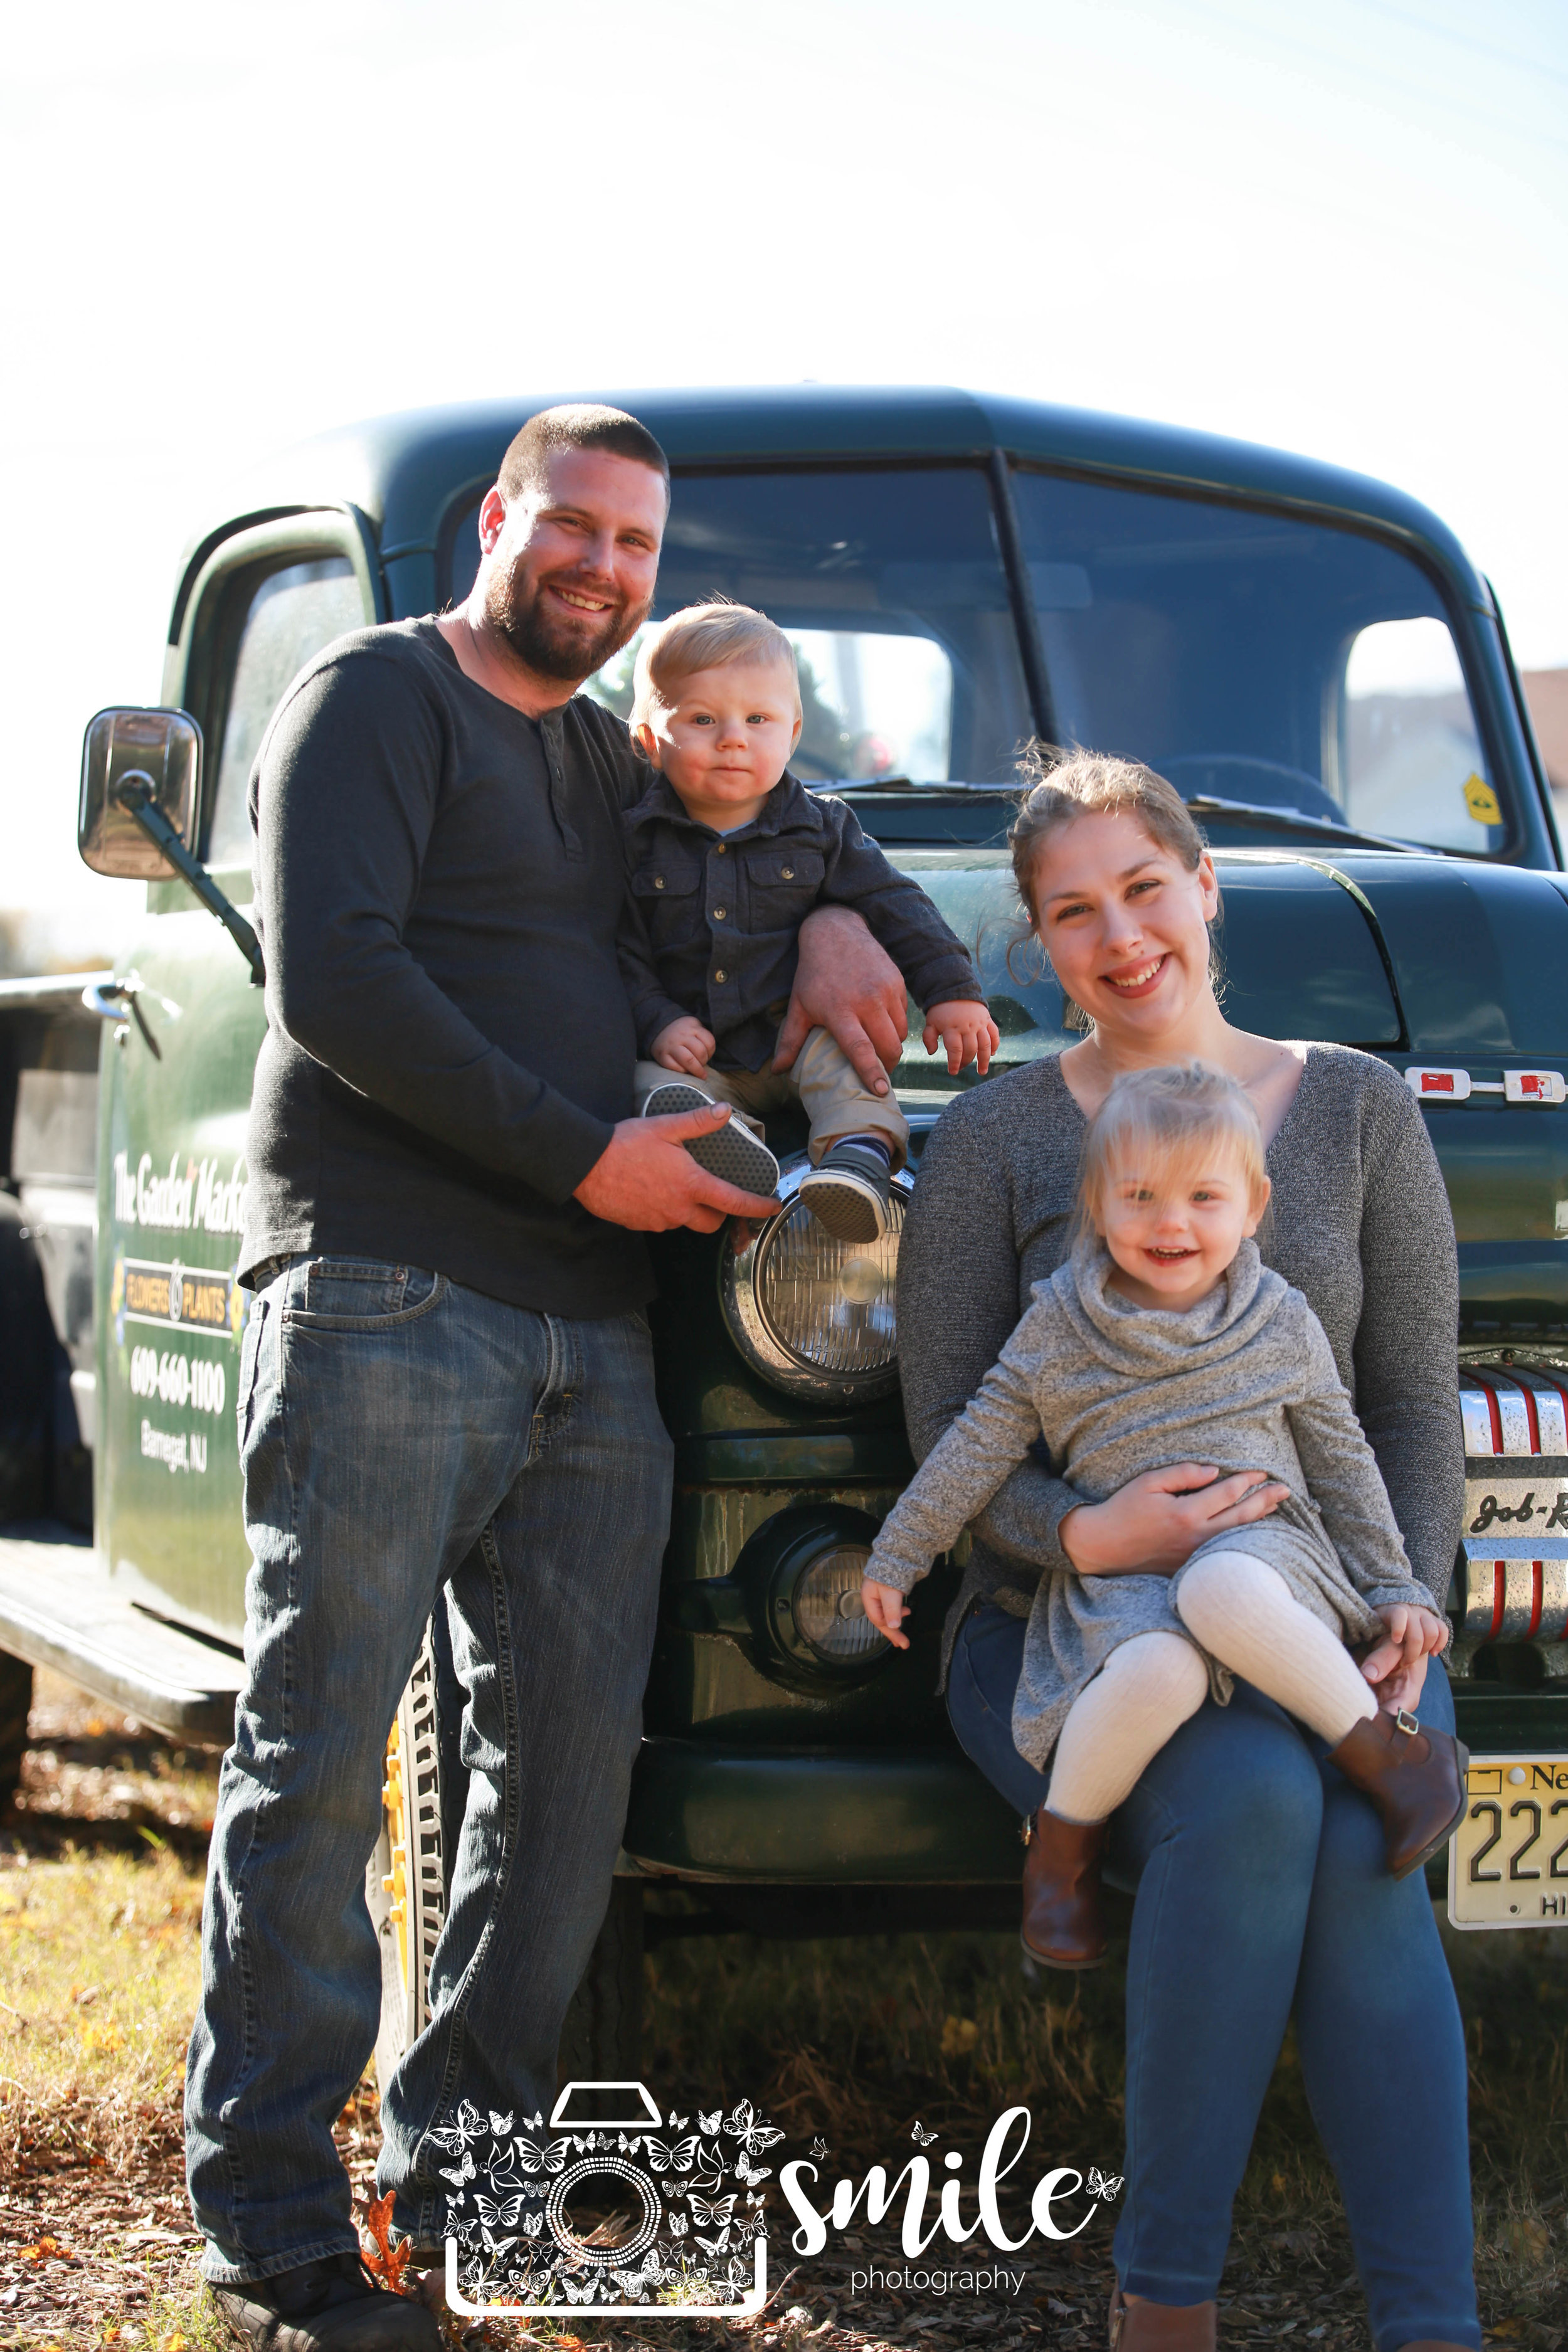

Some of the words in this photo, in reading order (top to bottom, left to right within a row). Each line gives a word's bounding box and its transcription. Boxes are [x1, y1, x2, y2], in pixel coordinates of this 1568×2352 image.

[114, 1149, 137, 1223] The
[137, 1152, 193, 1229] Garden
[127, 1274, 169, 1313] FLOWERS
[184, 1284, 226, 1323] PLANTS
[131, 1346, 225, 1414] 609-660-1100
[189, 1433, 208, 1473] NJ
